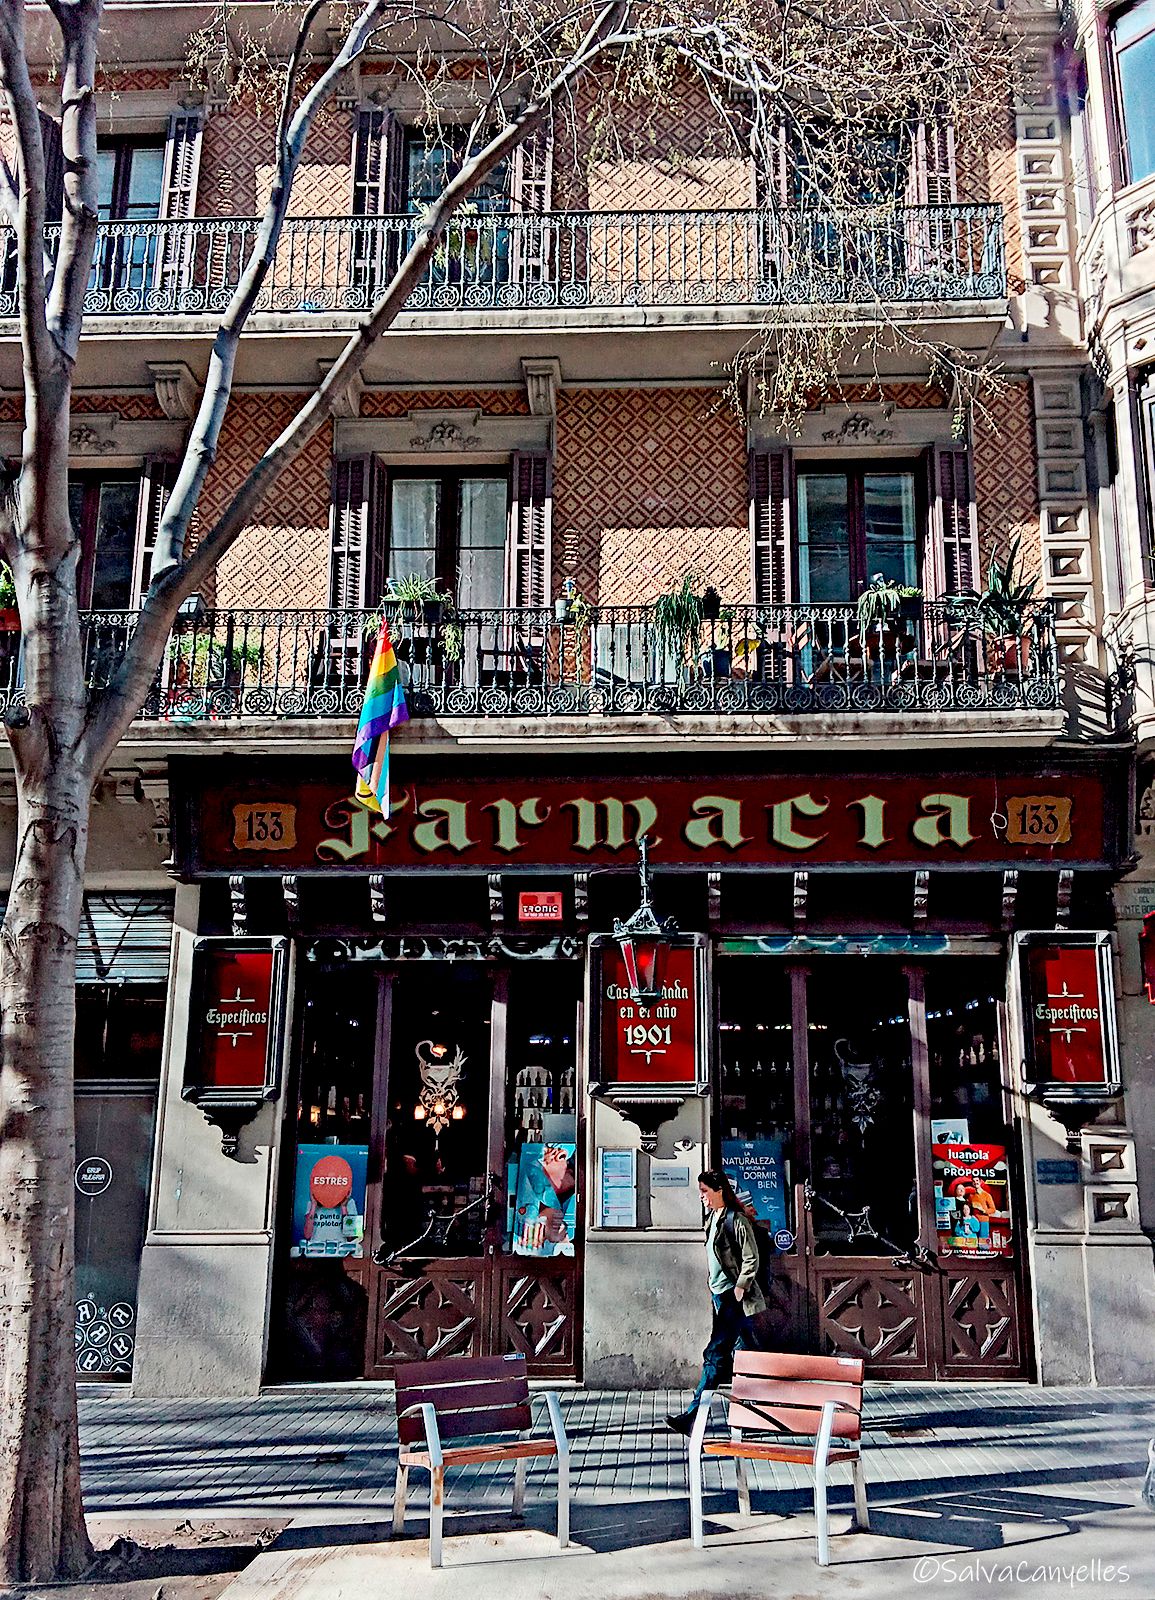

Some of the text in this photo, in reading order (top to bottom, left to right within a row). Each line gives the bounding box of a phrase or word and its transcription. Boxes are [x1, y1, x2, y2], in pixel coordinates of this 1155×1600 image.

[243, 811, 284, 841] 133
[316, 790, 982, 862] Farmacia
[1018, 804, 1058, 835] 133
[606, 984, 632, 1000] Cas
[620, 1006, 634, 1018] en
[656, 1003, 677, 1018] año
[623, 1024, 672, 1046] 1901
[721, 1156, 776, 1166] NATURALEZA
[743, 1171, 777, 1180] DORMIR
[943, 1167, 996, 1178] PRÓPOLIS
[313, 1176, 348, 1185] ESTRÉS
[757, 1180, 778, 1189] BIEN
